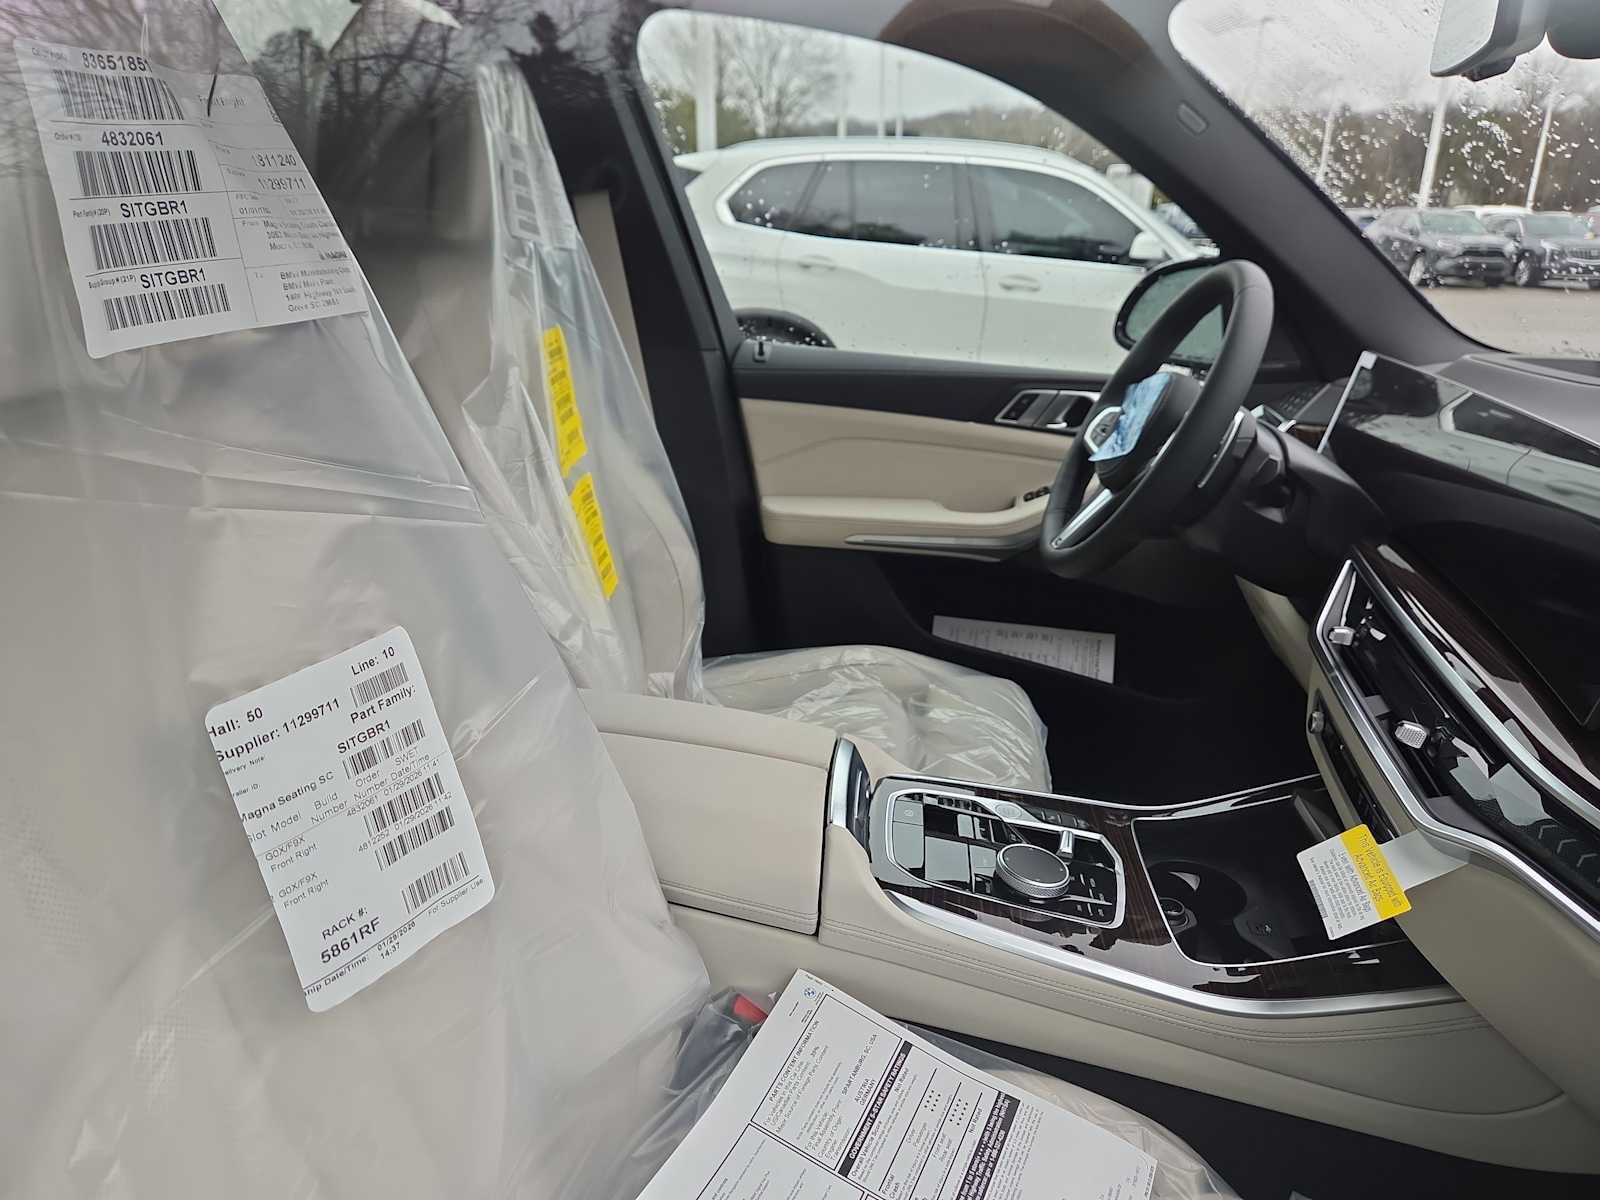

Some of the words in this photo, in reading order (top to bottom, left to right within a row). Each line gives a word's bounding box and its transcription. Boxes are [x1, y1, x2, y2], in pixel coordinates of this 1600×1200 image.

[102, 131, 164, 146] 4832061
[120, 199, 188, 218] SITGBR1
[140, 268, 206, 289] SITGBR1
[349, 654, 378, 675] Line:
[380, 645, 395, 659] 10
[244, 706, 263, 723] 50
[349, 704, 375, 723] Part
[376, 684, 417, 712] Family:
[214, 725, 281, 764] Supplier:
[282, 698, 340, 733] 11299711
[335, 719, 391, 753] SITGBR1
[269, 810, 302, 832] Model
[312, 791, 338, 809] Build
[353, 768, 380, 787] Order
[275, 780, 318, 807] Seating
[316, 770, 334, 784] SC
[309, 797, 348, 824] Number
[352, 776, 388, 801] Number
[388, 752, 430, 781] Date/Time
[269, 855, 294, 872] Front
[293, 842, 318, 861] Right
[282, 891, 306, 908] Front
[306, 878, 329, 897] Right
[439, 886, 469, 909] Supplier
[469, 878, 483, 890] Use
[317, 917, 383, 963] 5861RF
[319, 912, 355, 940] RACK
[379, 941, 401, 959] 14:37
[768, 1080, 783, 1102] PARTS
[780, 1055, 798, 1082] CONTENT
[848, 1118, 873, 1159] GOVERNMENT
